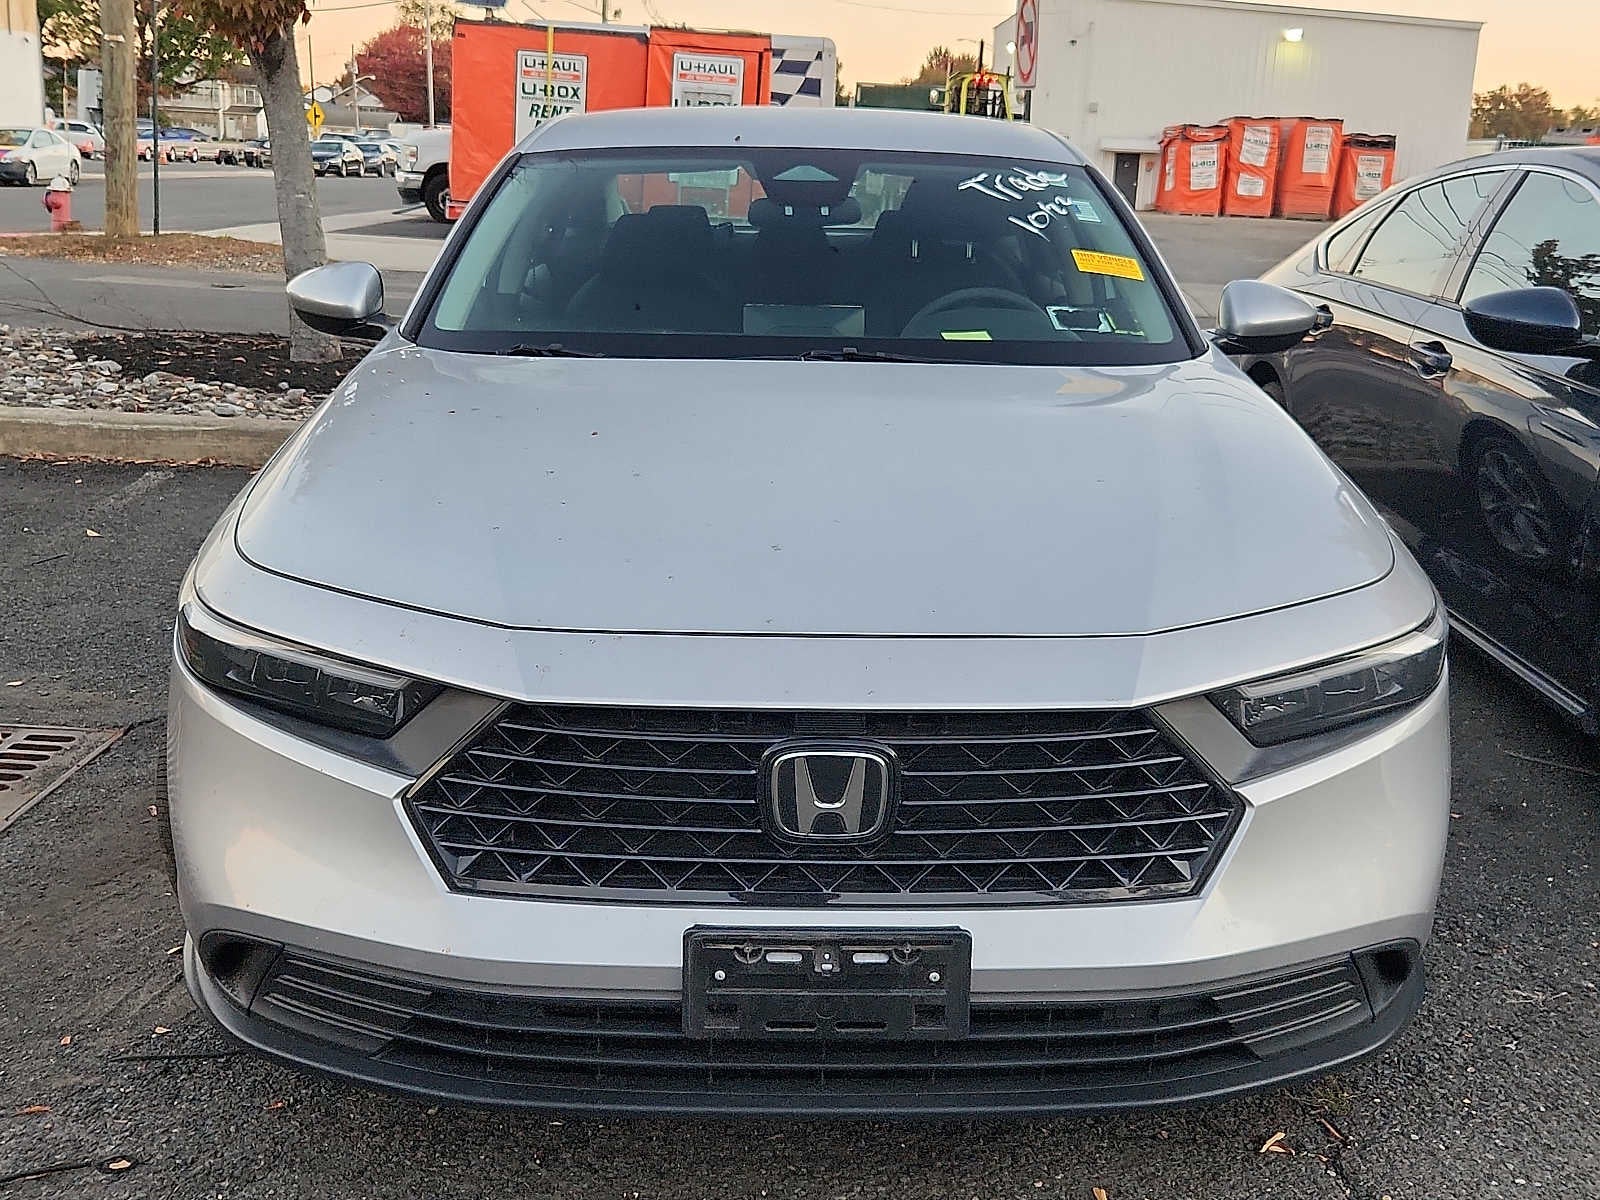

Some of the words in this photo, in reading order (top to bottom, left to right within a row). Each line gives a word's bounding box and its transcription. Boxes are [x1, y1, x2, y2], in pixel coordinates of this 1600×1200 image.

[524, 58, 581, 73] U-HAUL
[680, 60, 736, 75] U-HAUL
[521, 82, 581, 100] U-BOX
[528, 103, 574, 119] RENT
